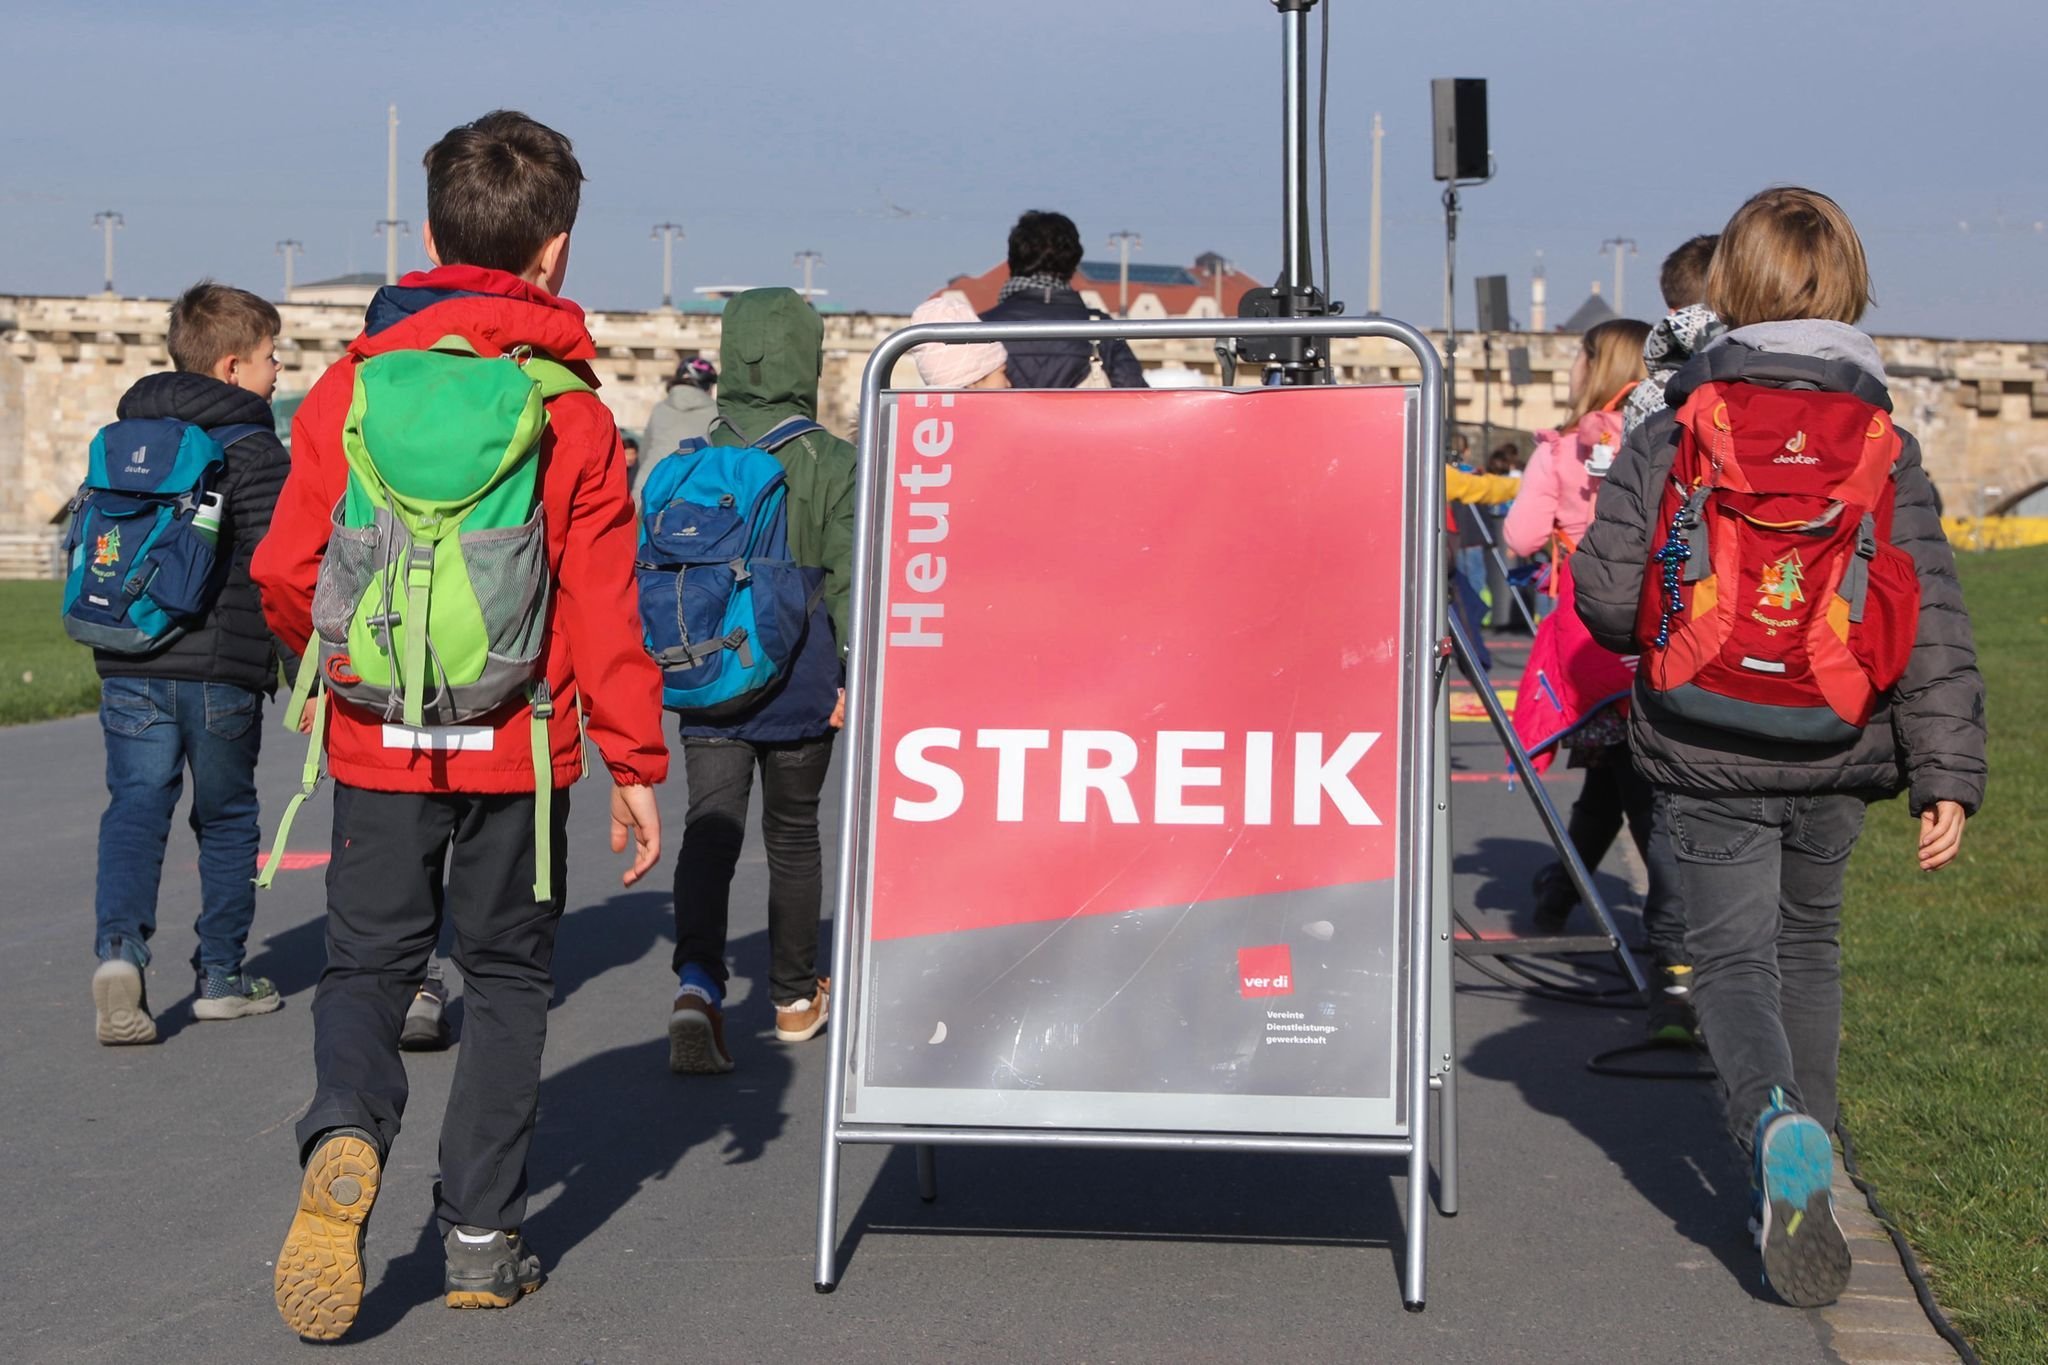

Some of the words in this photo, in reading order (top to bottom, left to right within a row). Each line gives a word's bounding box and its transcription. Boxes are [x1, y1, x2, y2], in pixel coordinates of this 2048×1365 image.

[1772, 453, 1820, 464] deuter
[889, 394, 955, 647] Heute:
[892, 727, 1384, 826] STREIK
[1266, 1011, 1304, 1019] Vereinte
[1266, 1023, 1339, 1034] Dienstleistungs-
[1266, 1035, 1327, 1045] gewerkschaft
